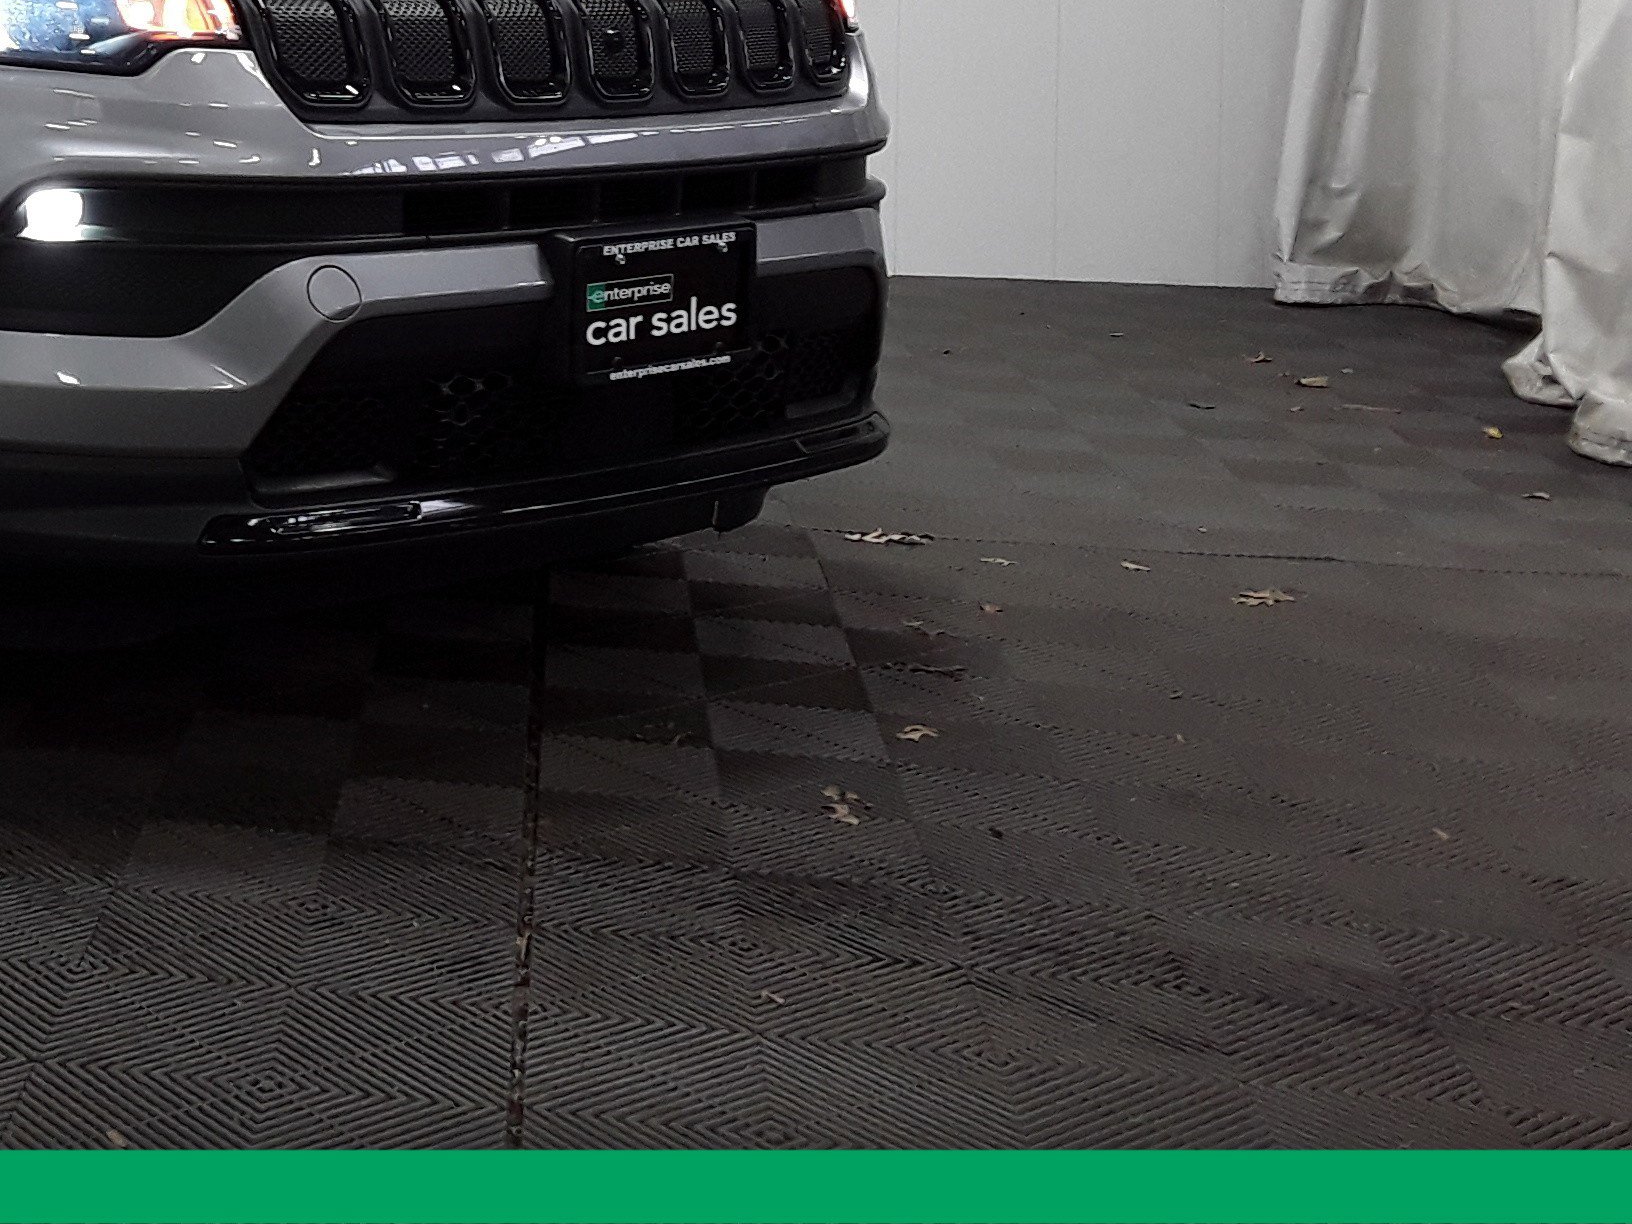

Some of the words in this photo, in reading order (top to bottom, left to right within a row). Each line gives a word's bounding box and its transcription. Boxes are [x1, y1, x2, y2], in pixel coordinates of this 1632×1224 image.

[603, 238, 674, 256] ENTERPRISE
[676, 235, 700, 248] CAR
[701, 232, 737, 245] SALES
[590, 280, 672, 303] enterprise
[585, 314, 644, 346] car
[650, 295, 738, 337] sales
[609, 355, 732, 381] enterprisecarsales.com
